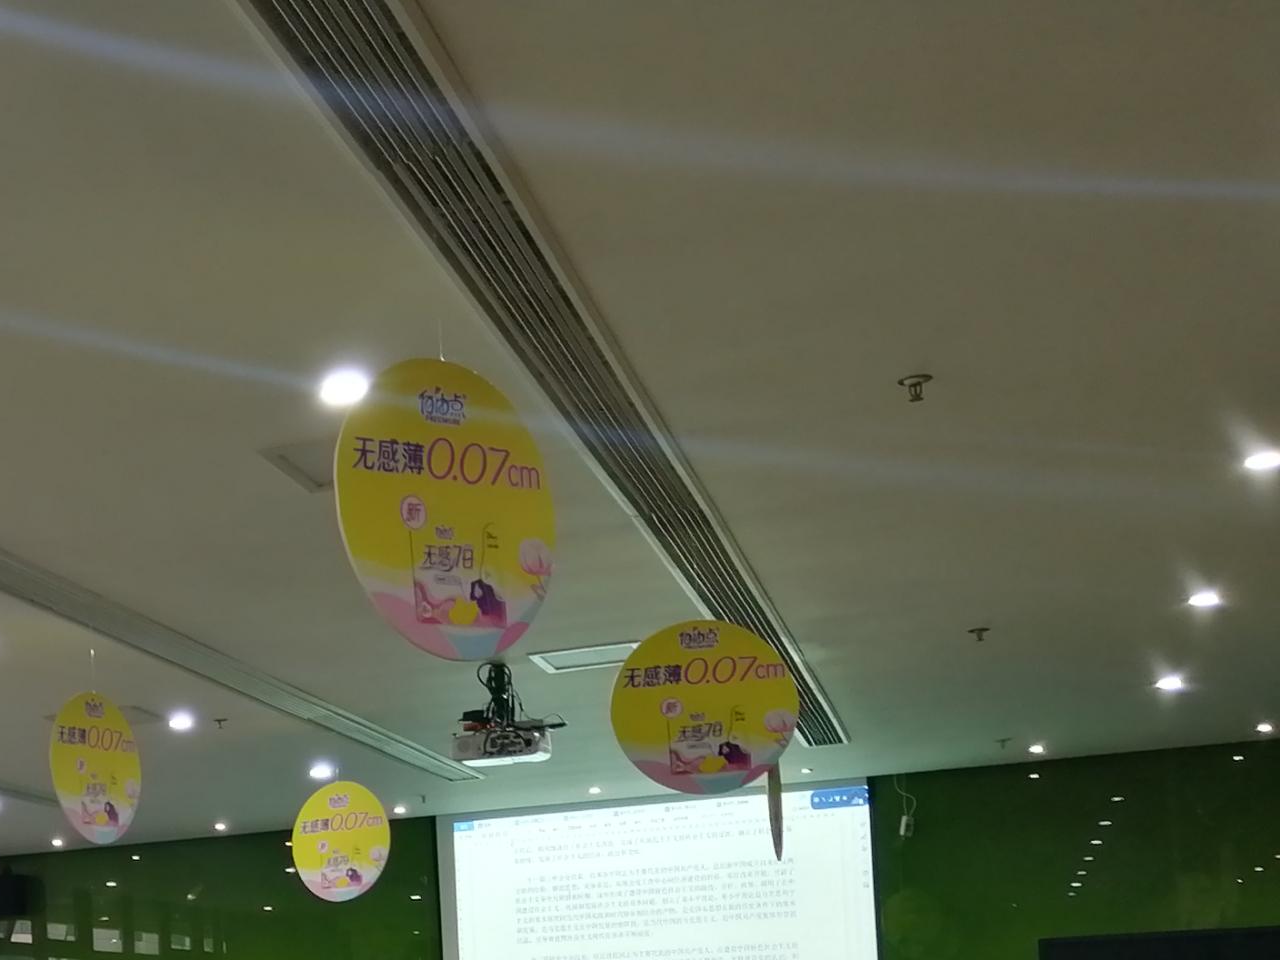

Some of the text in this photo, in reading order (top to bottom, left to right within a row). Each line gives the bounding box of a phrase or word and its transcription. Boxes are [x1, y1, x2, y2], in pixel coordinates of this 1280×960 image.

[352, 436, 541, 490] 无感薄0.07cm
[406, 503, 422, 522] 新
[623, 656, 786, 688] 无感薄0.07cm
